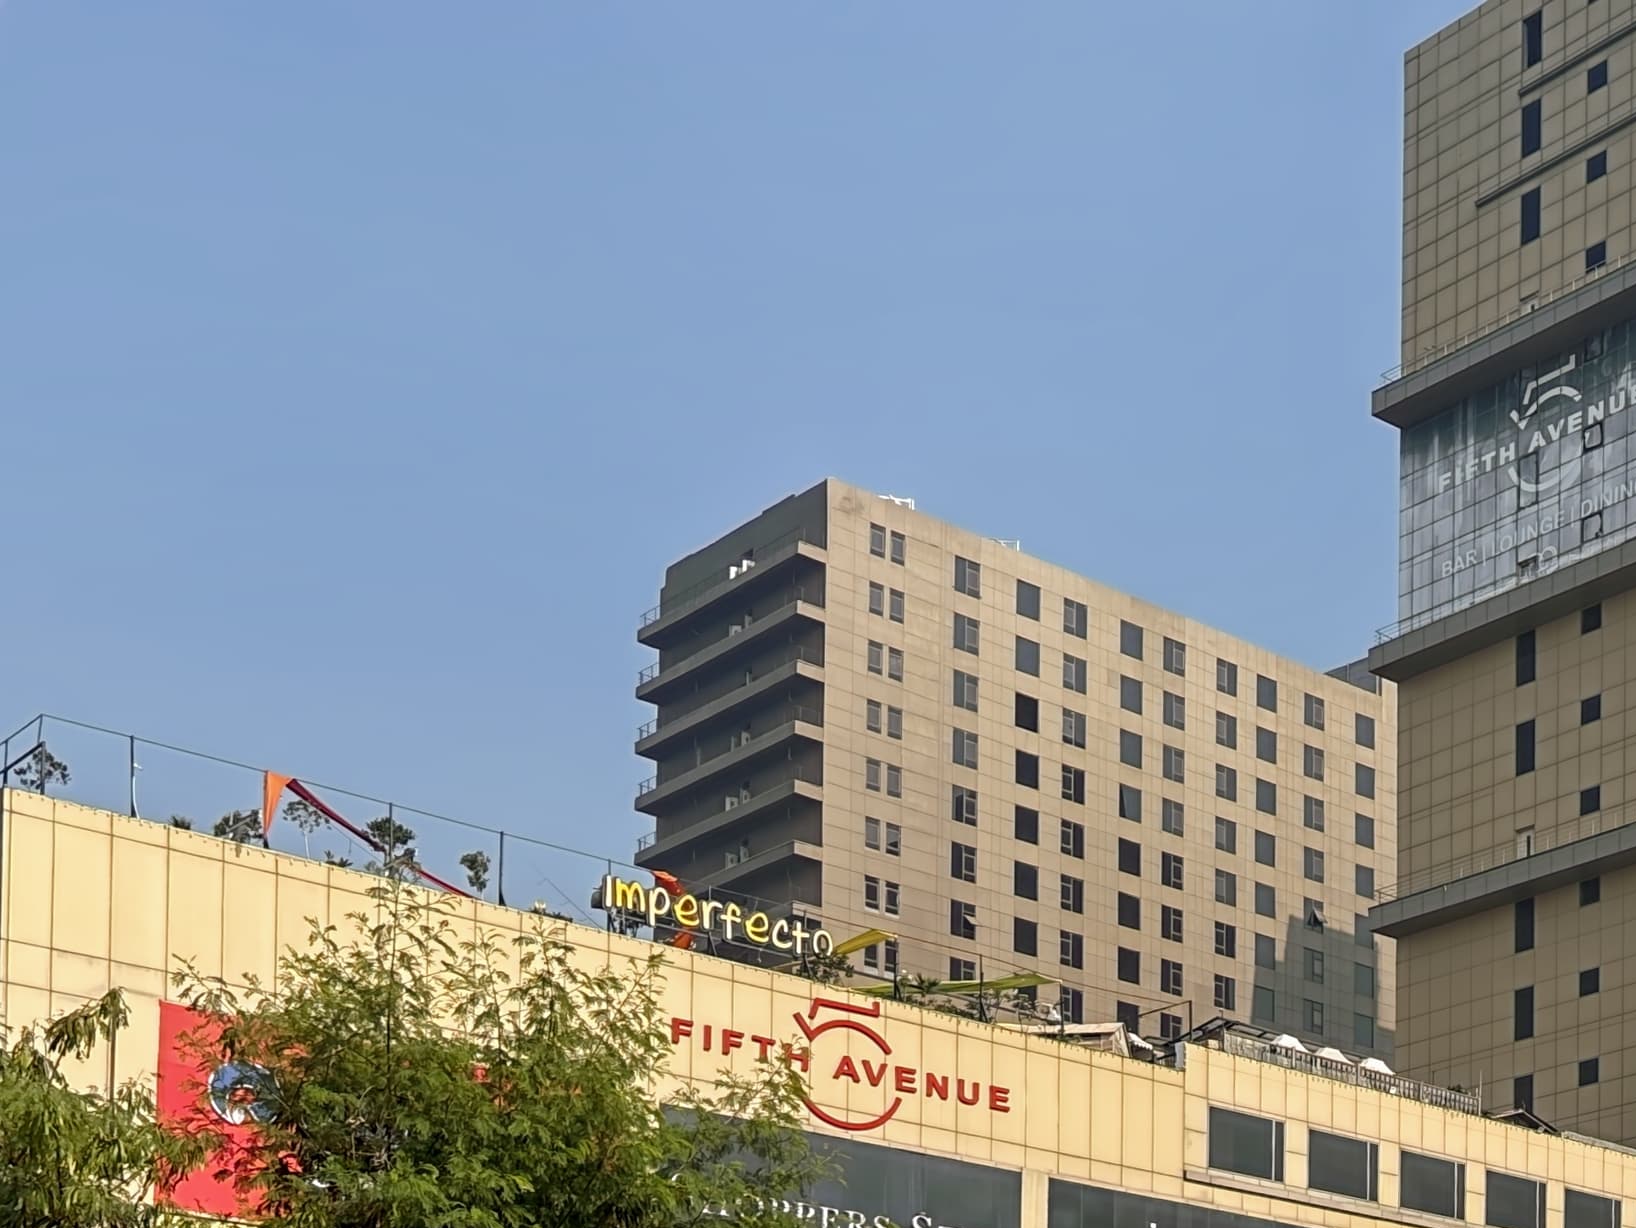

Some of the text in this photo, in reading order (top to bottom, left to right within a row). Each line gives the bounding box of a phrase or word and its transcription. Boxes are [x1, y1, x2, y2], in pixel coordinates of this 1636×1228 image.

[1438, 442, 1516, 493] FIFTH
[1441, 550, 1477, 578] BAR
[671, 1018, 1011, 1113] FIFTH AVENUE
